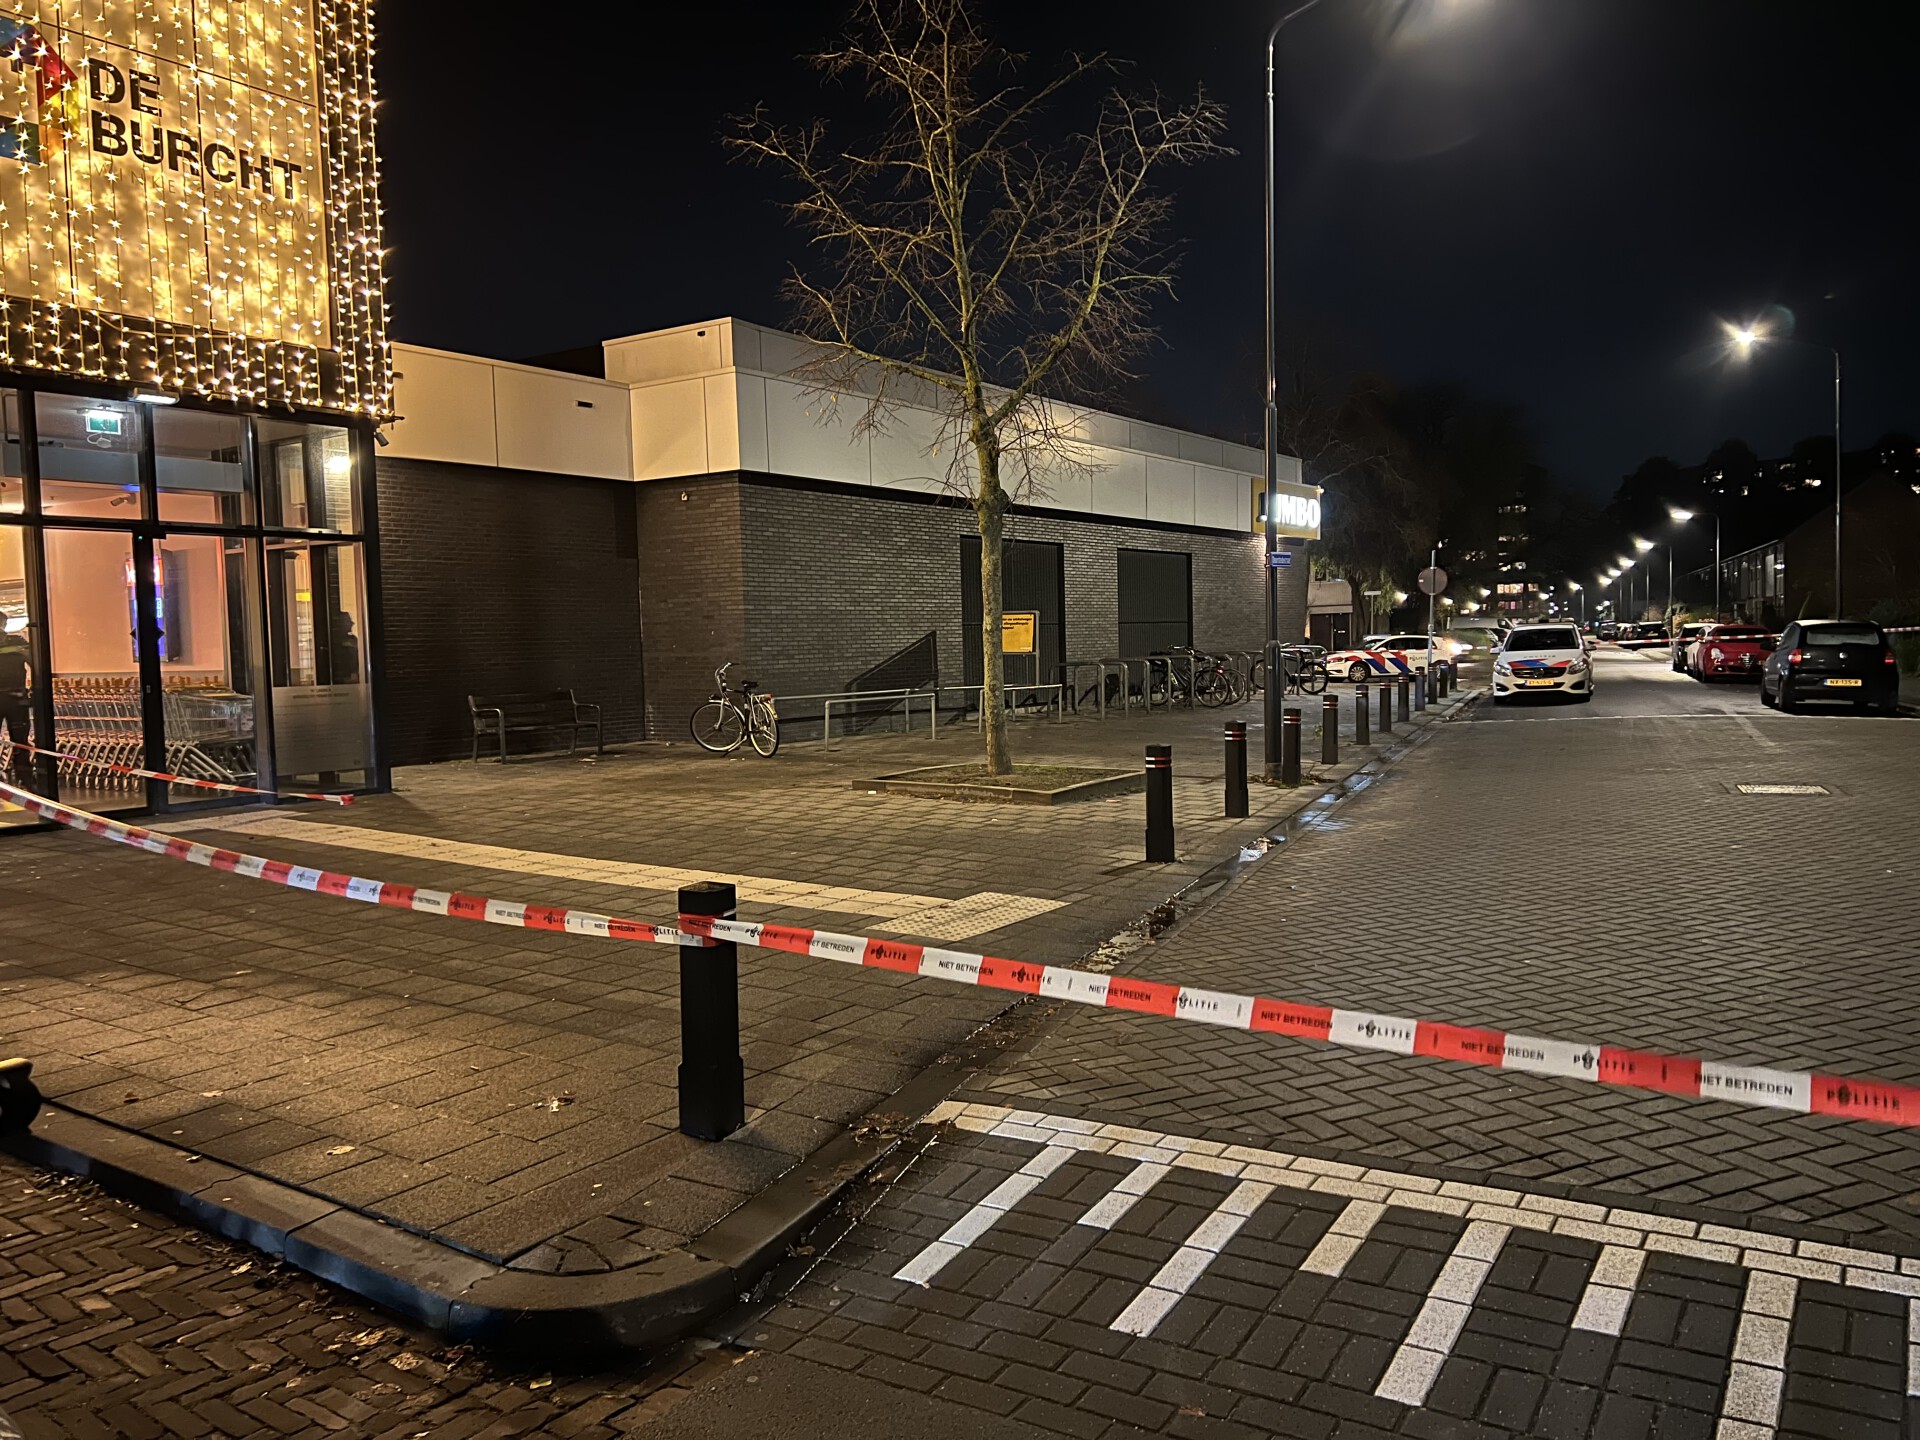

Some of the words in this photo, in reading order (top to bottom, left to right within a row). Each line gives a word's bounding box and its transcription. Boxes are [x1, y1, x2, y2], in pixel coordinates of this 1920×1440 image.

[88, 57, 162, 117] DE
[91, 109, 303, 200] BURCHT
[805, 938, 820, 949] NIET
[820, 940, 855, 954] BETREDEN
[871, 943, 907, 961] POLITIE
[938, 960, 955, 970] NIET
[955, 962, 994, 976] BETREDEN
[1011, 965, 1052, 985] POLITIE
[1088, 983, 1107, 995] NIET
[1107, 986, 1151, 1002] BETREDEN
[1172, 991, 1219, 1012] POLITIE
[1261, 1010, 1281, 1023] NIET
[1283, 1014, 1334, 1030] BETREDEN
[1357, 1018, 1412, 1041] POLITIE
[1461, 1041, 1483, 1054] NIET
[1486, 1044, 1545, 1061] BETREDEN
[1573, 1046, 1636, 1073] POLITIE
[1694, 1071, 1722, 1087] NIET
[1725, 1074, 1793, 1097] BETREDEN
[1826, 1083, 1901, 1110] POLITIE
